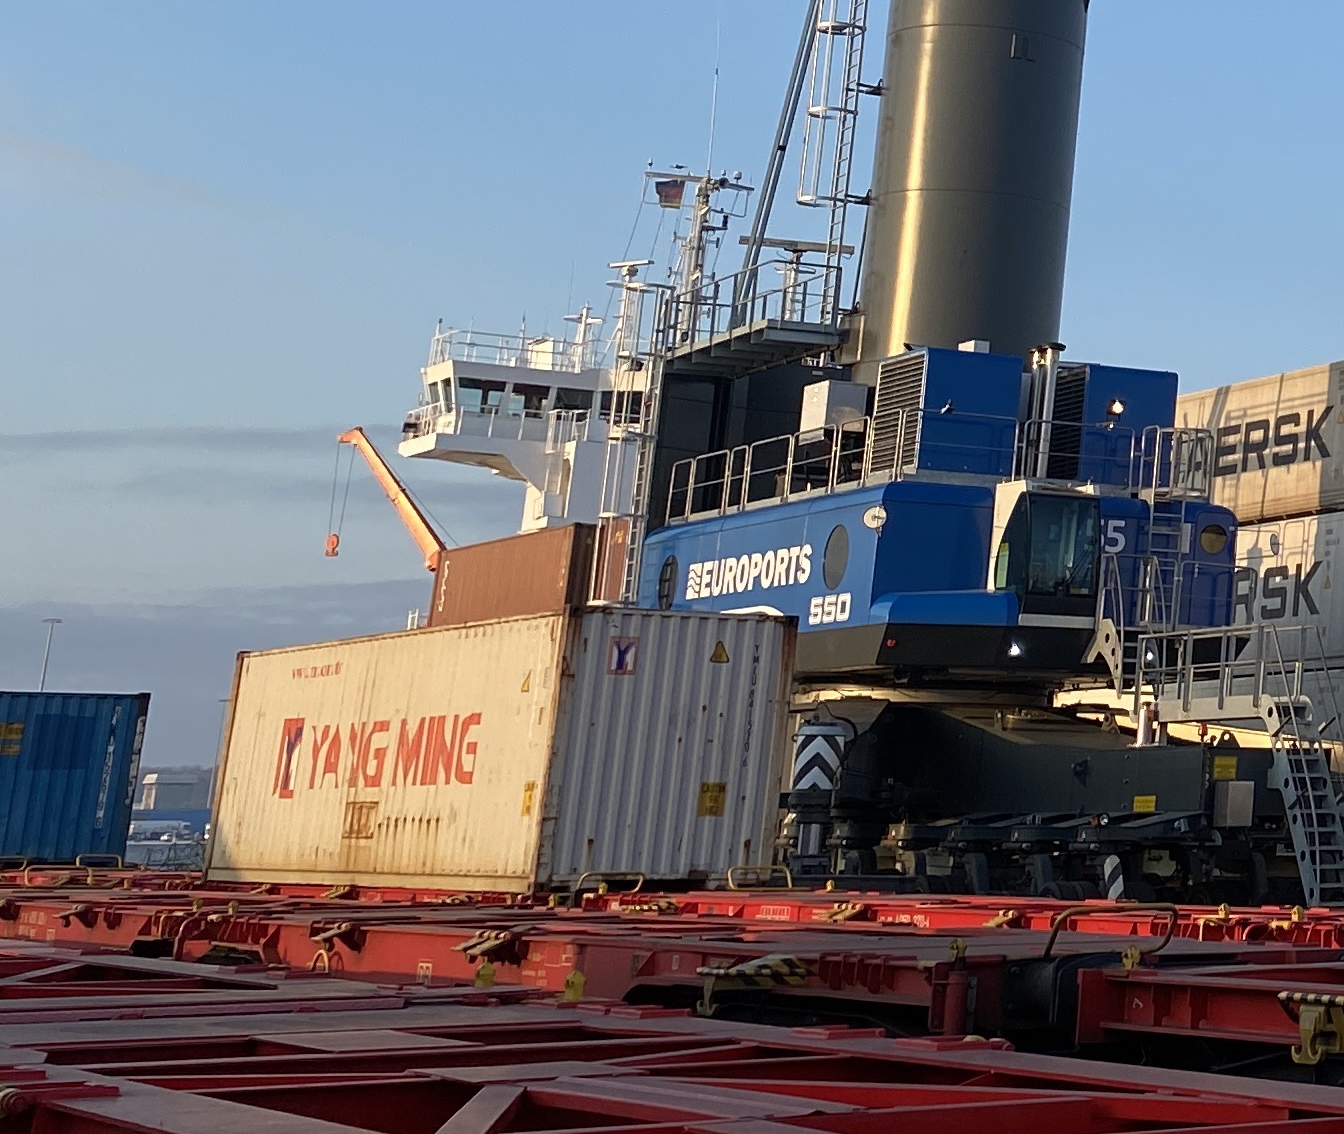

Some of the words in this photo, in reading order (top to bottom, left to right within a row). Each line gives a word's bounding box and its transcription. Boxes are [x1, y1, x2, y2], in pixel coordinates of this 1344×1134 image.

[1184, 406, 1335, 483] AERSK
[1100, 519, 1127, 553] 5
[700, 543, 813, 599] EUROPORTS
[808, 592, 852, 626] 550
[308, 719, 391, 790] YANG
[391, 712, 483, 787] MING
